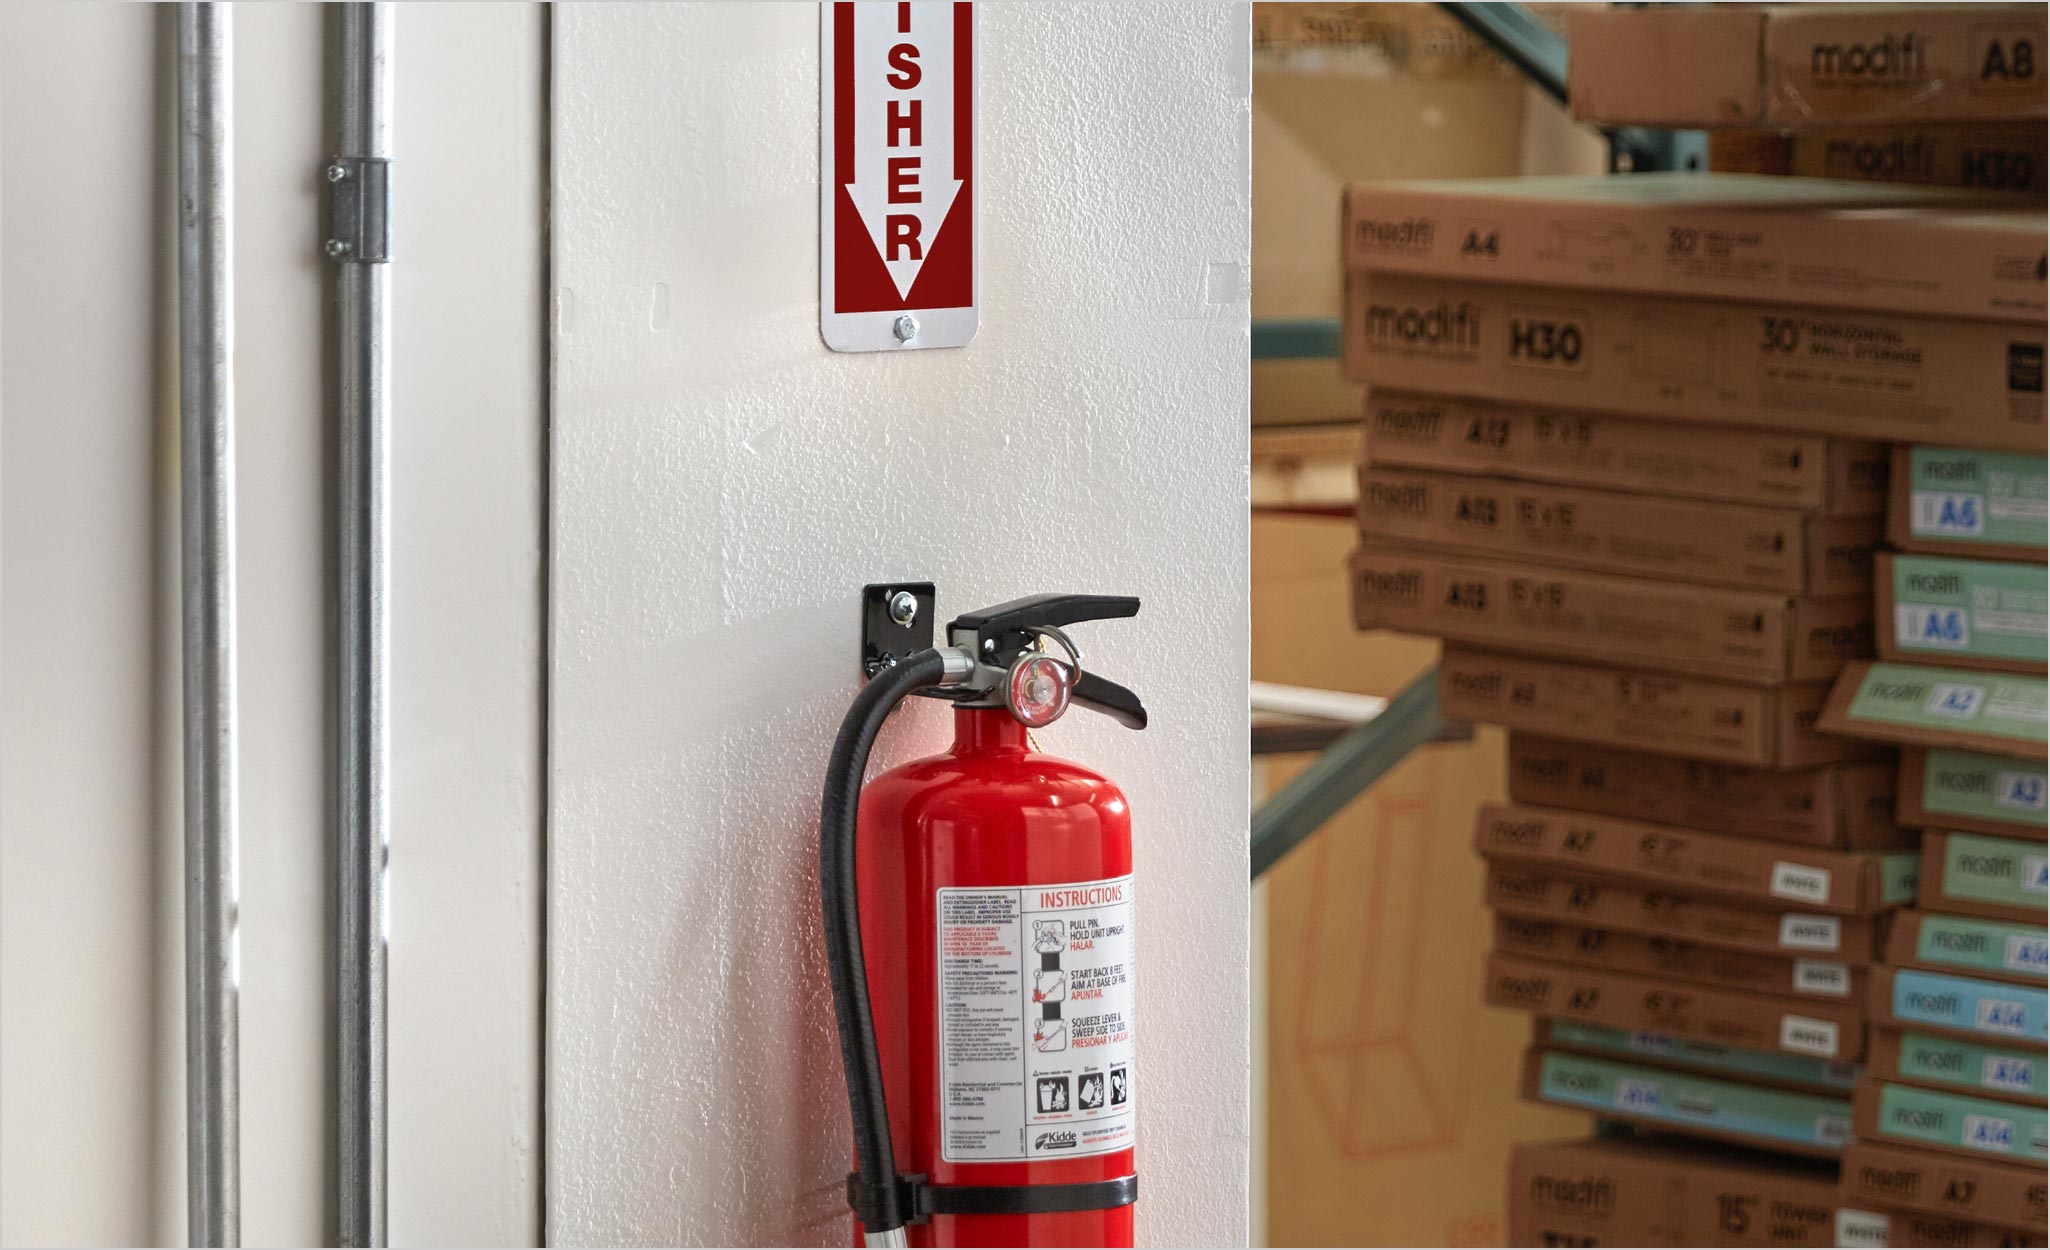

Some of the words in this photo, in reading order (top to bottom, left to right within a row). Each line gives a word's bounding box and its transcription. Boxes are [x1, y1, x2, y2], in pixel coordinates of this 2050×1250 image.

[1811, 32, 1926, 76] modifi
[1981, 39, 2034, 80] A8
[1461, 228, 1499, 258] A4
[1364, 302, 1483, 347] modifi
[1507, 319, 1582, 363] H30
[1938, 497, 1978, 528] A6
[1924, 611, 1962, 641] A6
[1040, 885, 1122, 908] INSTRUCTIONS
[1070, 921, 1088, 930] PULL
[1088, 919, 1100, 928] PIN.
[1070, 929, 1090, 940] HOLD
[1091, 927, 1106, 938] UNIT
[1070, 940, 1095, 951] HALAR.
[1071, 970, 1092, 980] START
[1093, 967, 1109, 978] BACK
[1109, 967, 1114, 976] 8
[1070, 979, 1085, 990] AIM
[1085, 978, 1096, 988] AT
[1096, 977, 1112, 987] BASE
[1112, 975, 1118, 985] OF
[1071, 989, 1103, 1001] APUNTAR.
[1072, 1016, 1101, 1028] SQUEEZE
[1101, 1014, 1117, 1025] LEVER
[1072, 1026, 1095, 1038] SWEEP
[1095, 1024, 1108, 1035] SIDE
[1109, 1023, 1117, 1034] TO
[1072, 1036, 1108, 1048] PRESIONAR
[1049, 1131, 1077, 1142] Kidde
